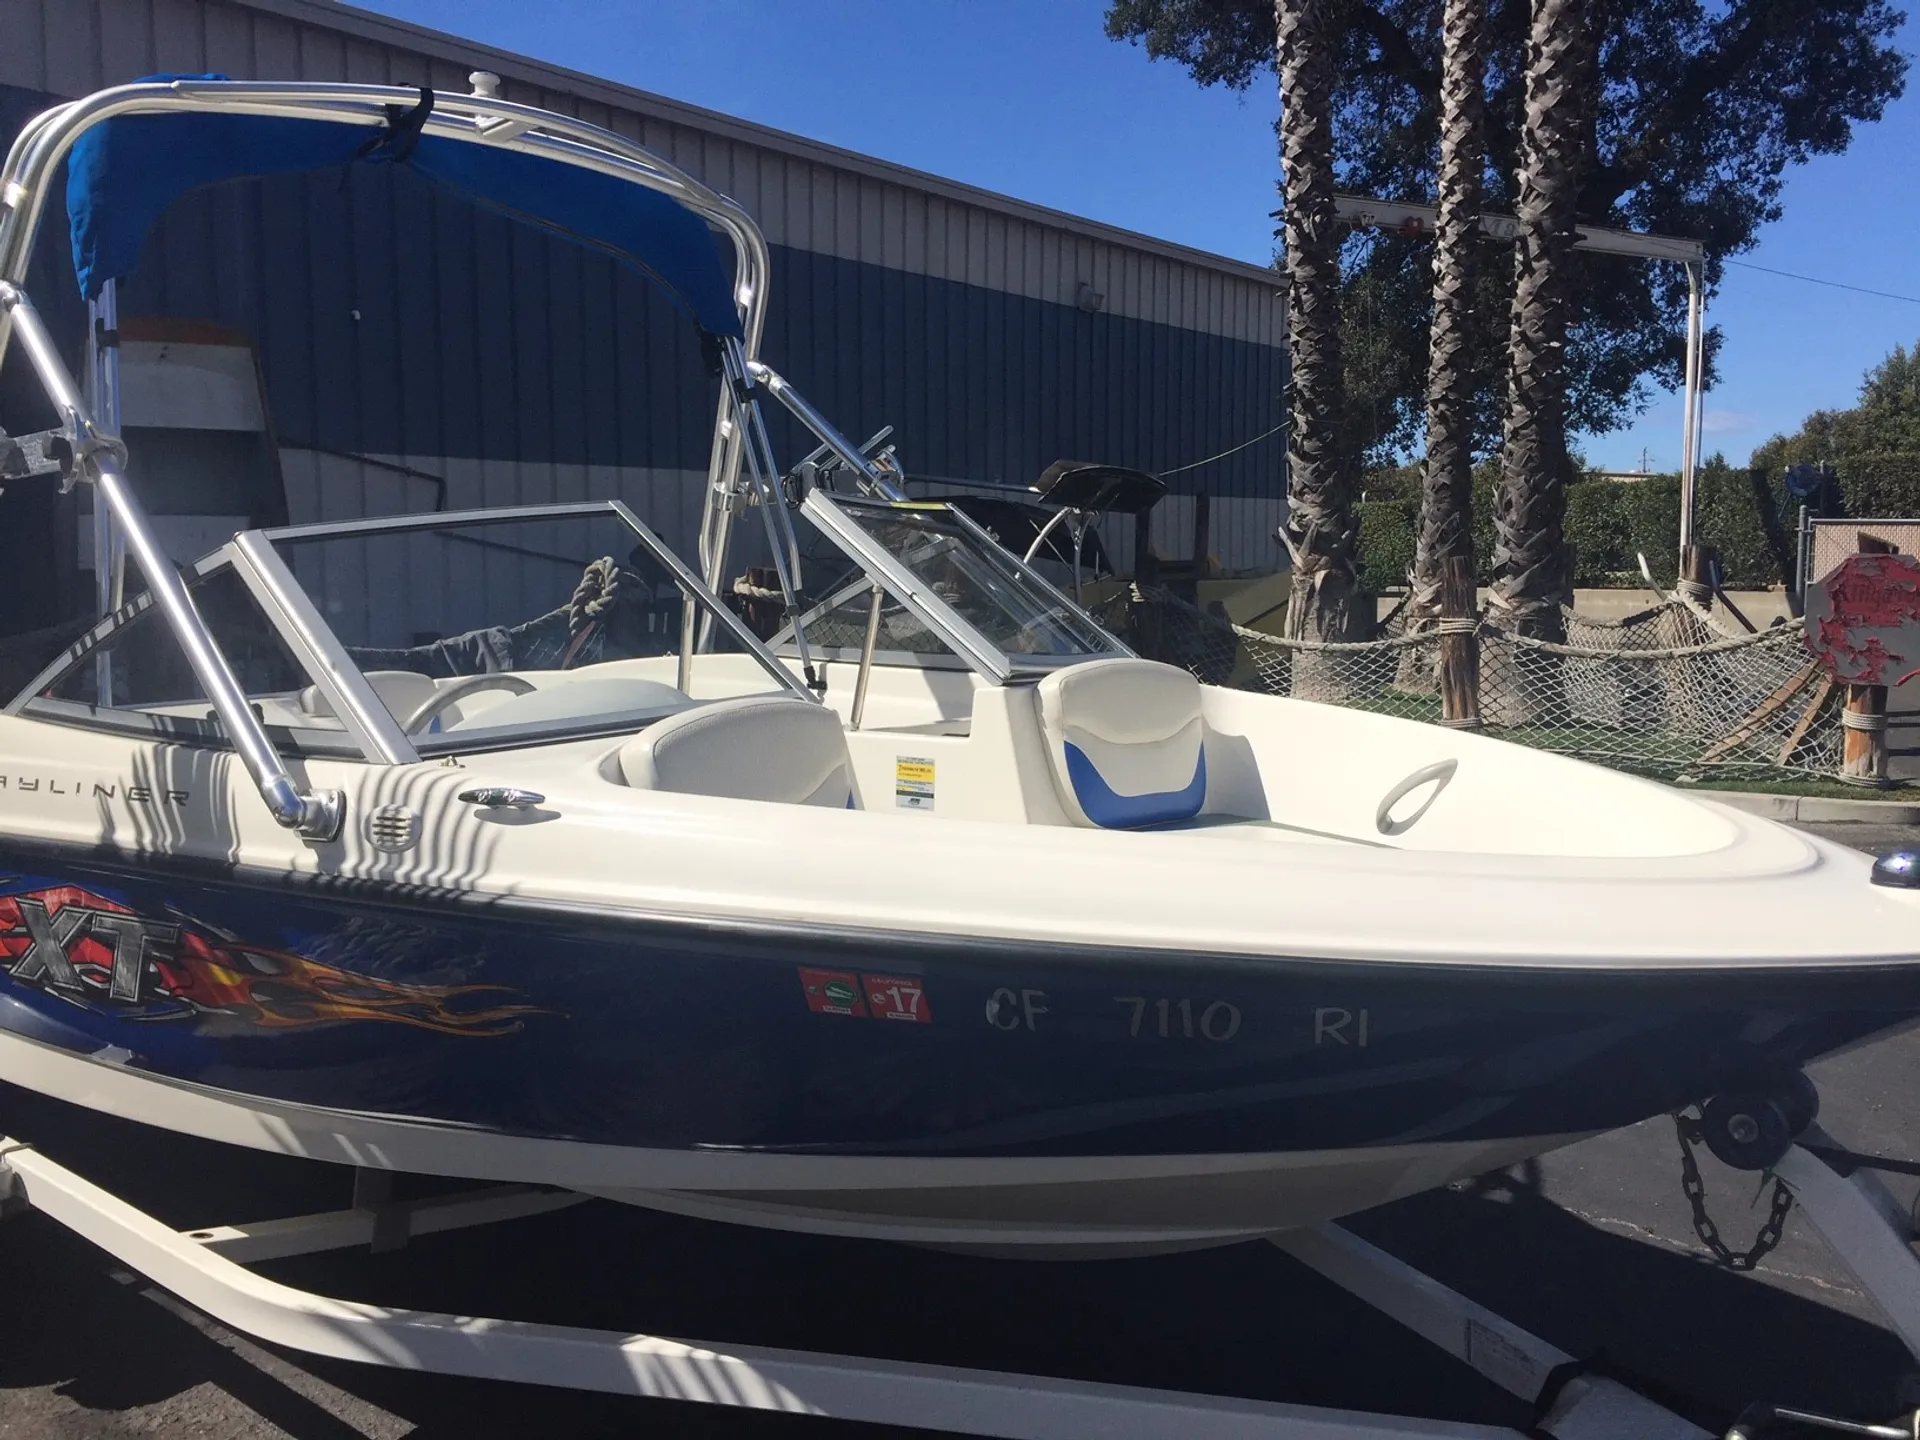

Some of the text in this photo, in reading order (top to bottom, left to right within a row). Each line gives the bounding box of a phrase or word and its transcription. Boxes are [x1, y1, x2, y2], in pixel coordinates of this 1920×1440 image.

[9, 897, 183, 1002] XT
[886, 986, 922, 1014] 17
[985, 987, 1050, 1032] CF
[1112, 996, 1243, 1042] 7110
